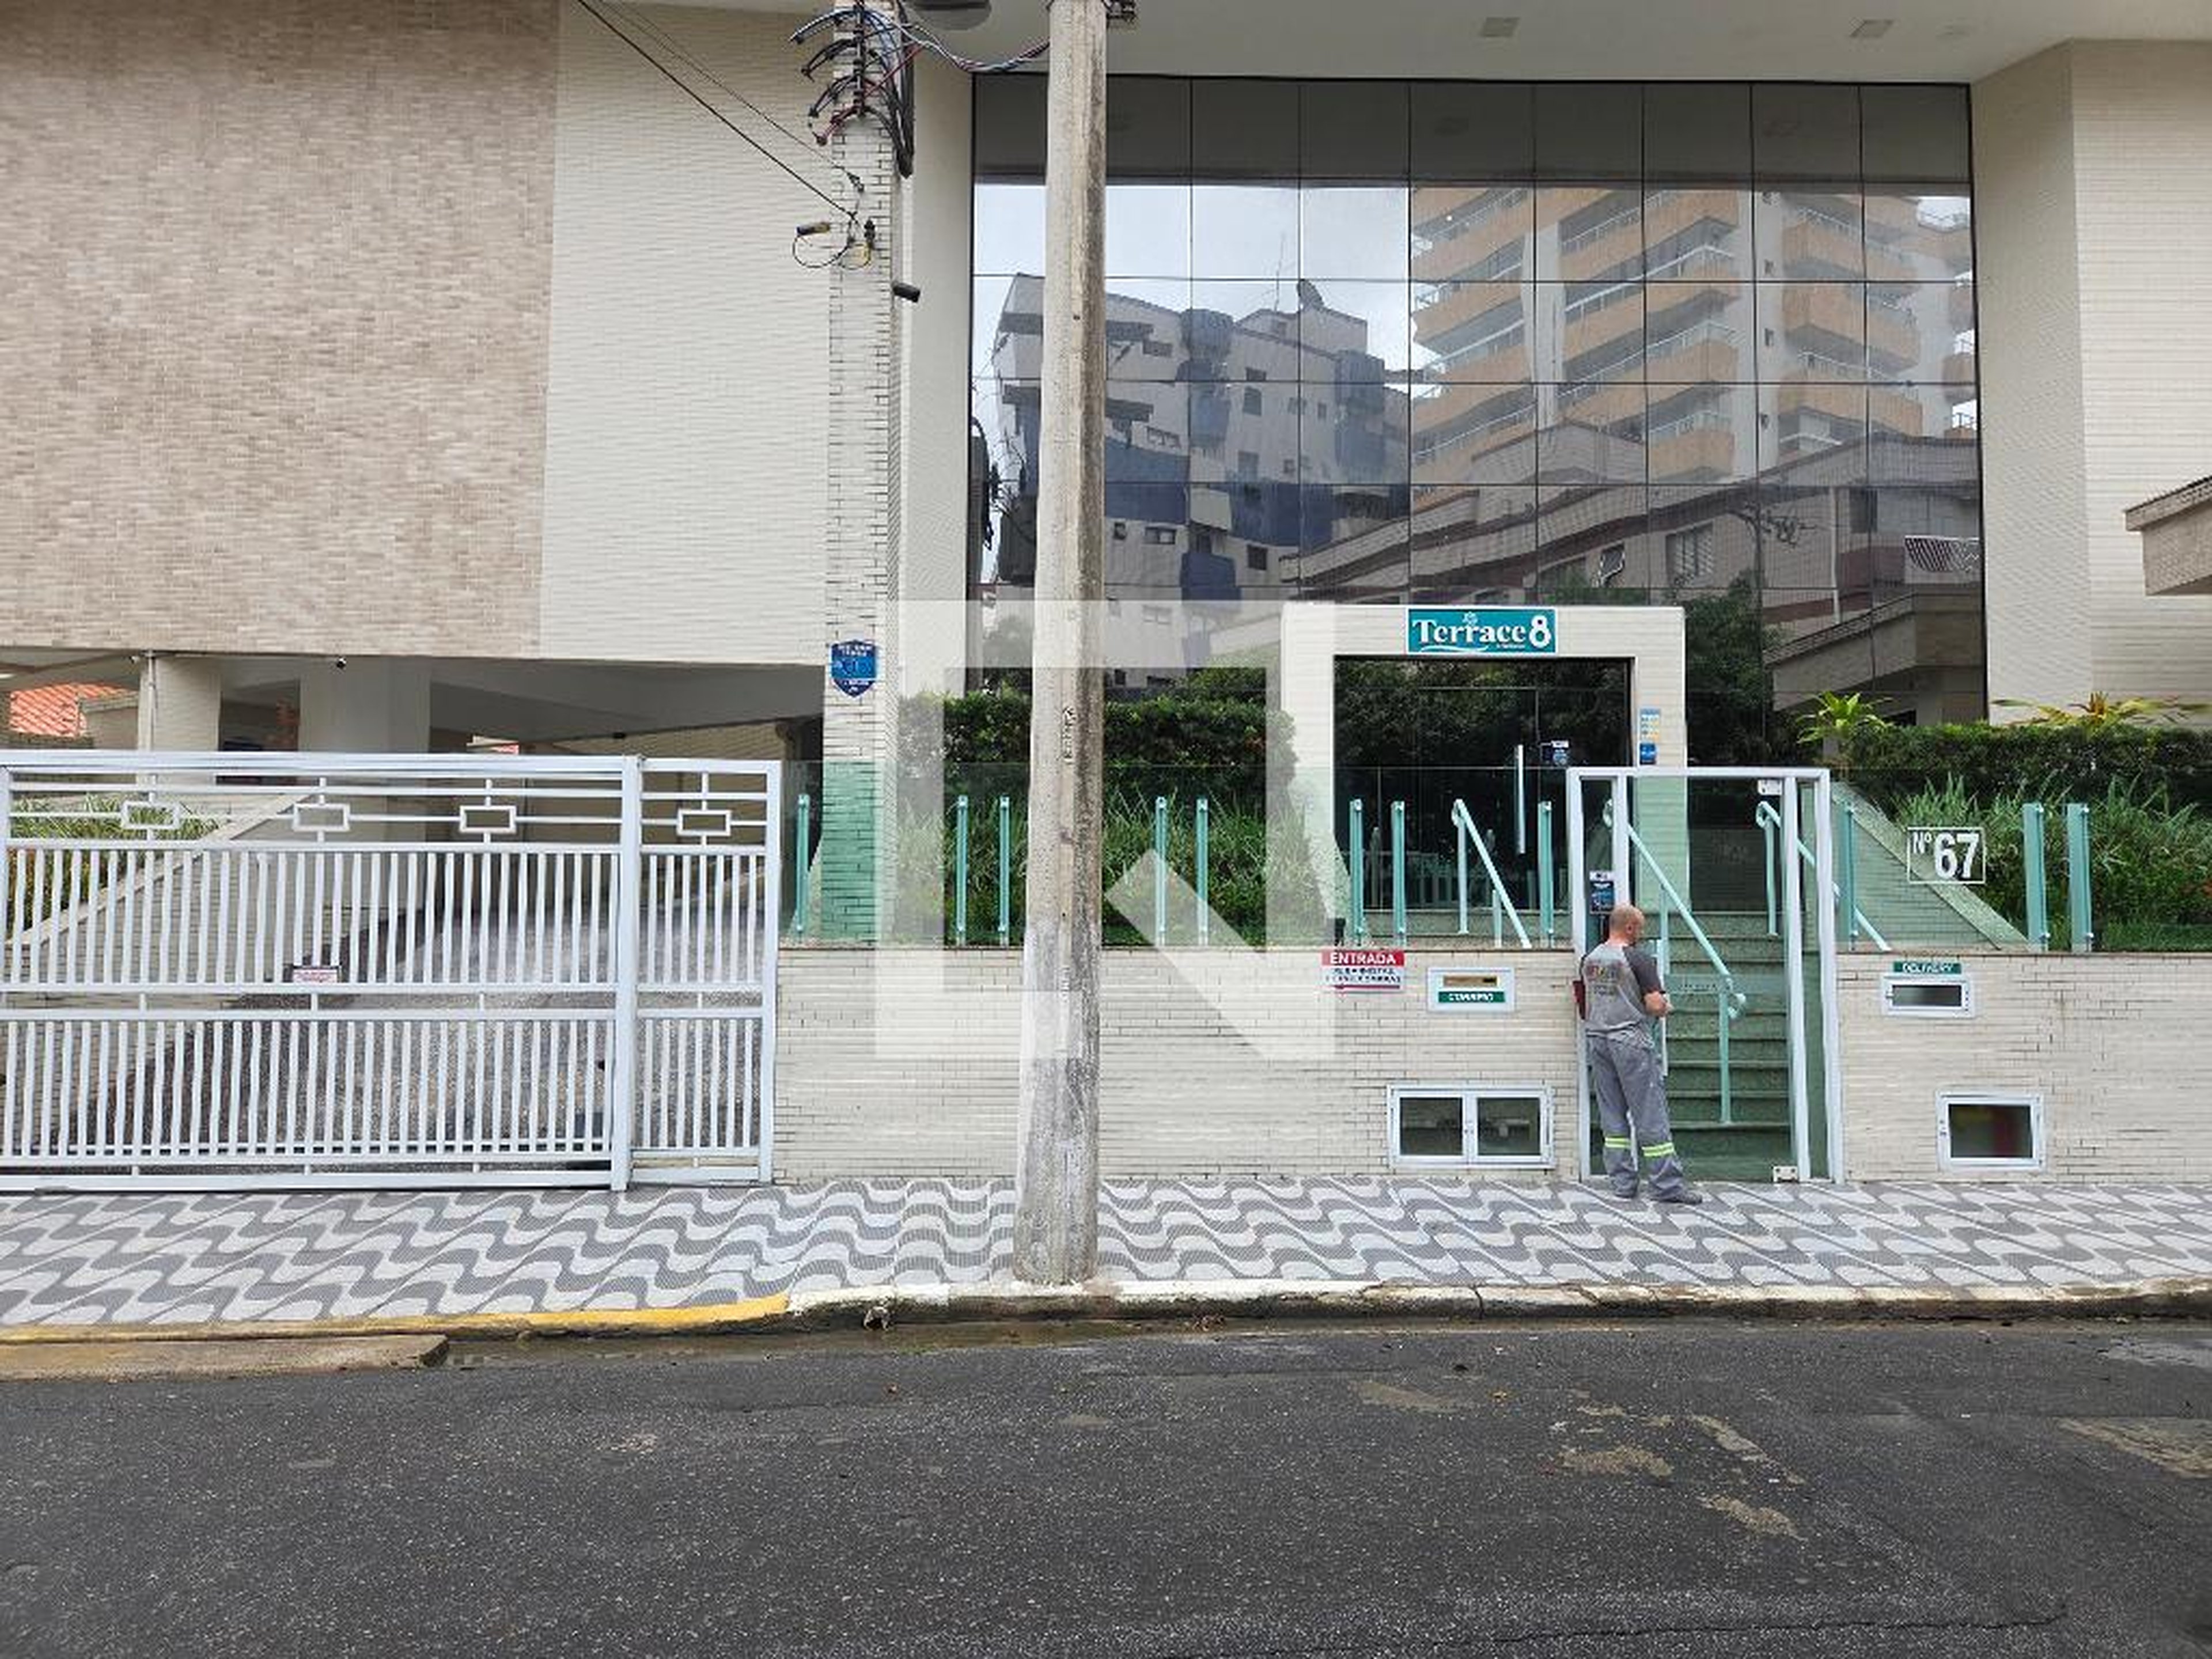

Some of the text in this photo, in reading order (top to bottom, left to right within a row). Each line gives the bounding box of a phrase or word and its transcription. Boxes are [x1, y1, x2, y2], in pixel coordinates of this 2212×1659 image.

[1412, 615, 1551, 648] Terrace 8
[1933, 832, 1980, 879] 67
[1330, 952, 1396, 964] ENTRADA
